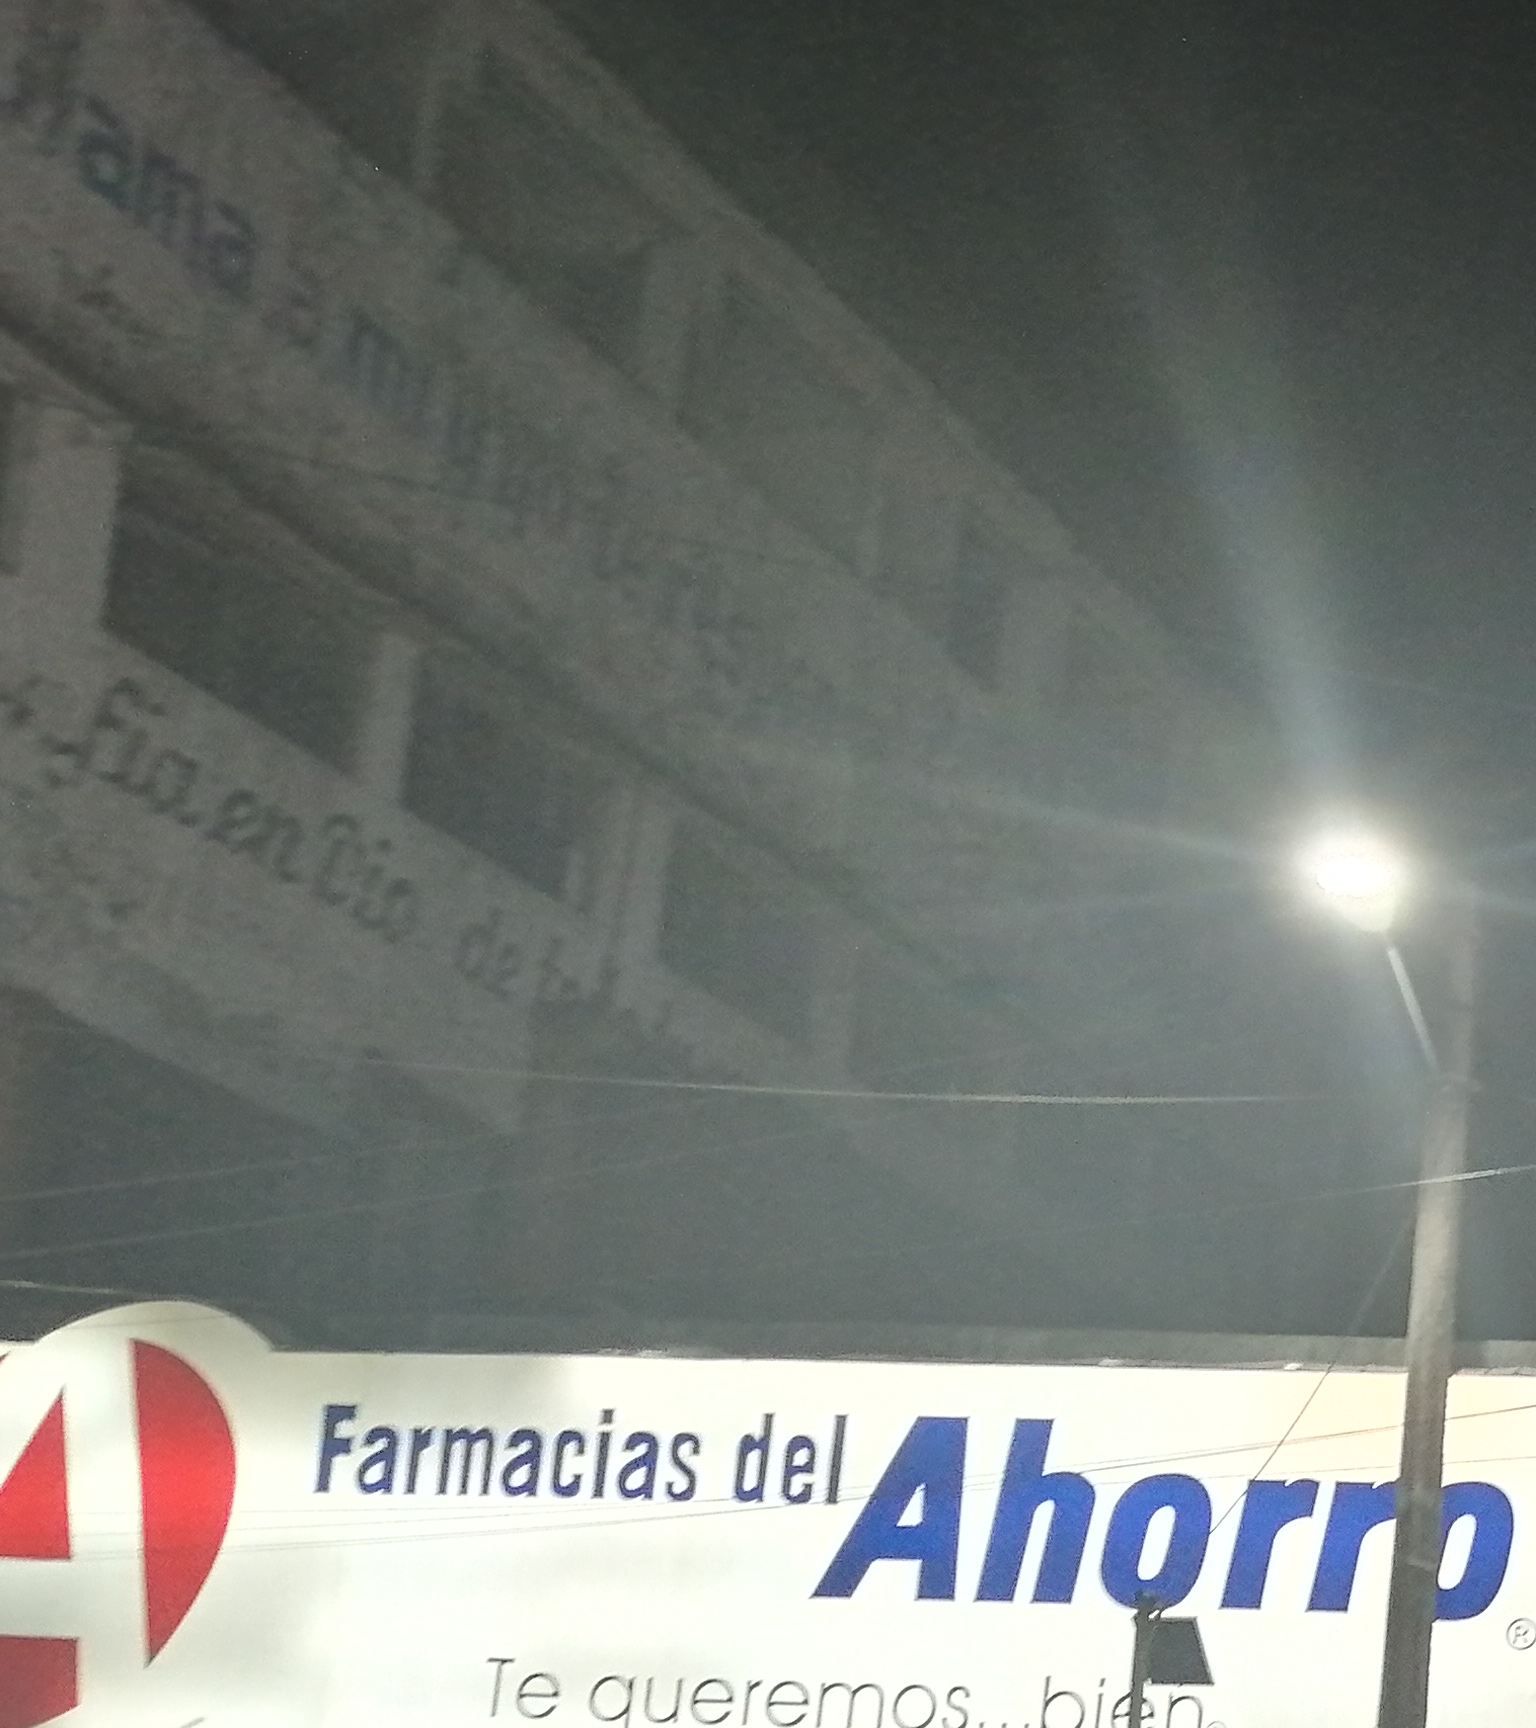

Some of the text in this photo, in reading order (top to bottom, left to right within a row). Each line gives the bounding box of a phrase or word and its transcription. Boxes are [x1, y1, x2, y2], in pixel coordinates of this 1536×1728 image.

[313, 1403, 1515, 1622] Farmacias del Ahorro
[487, 1657, 561, 1720] Te
